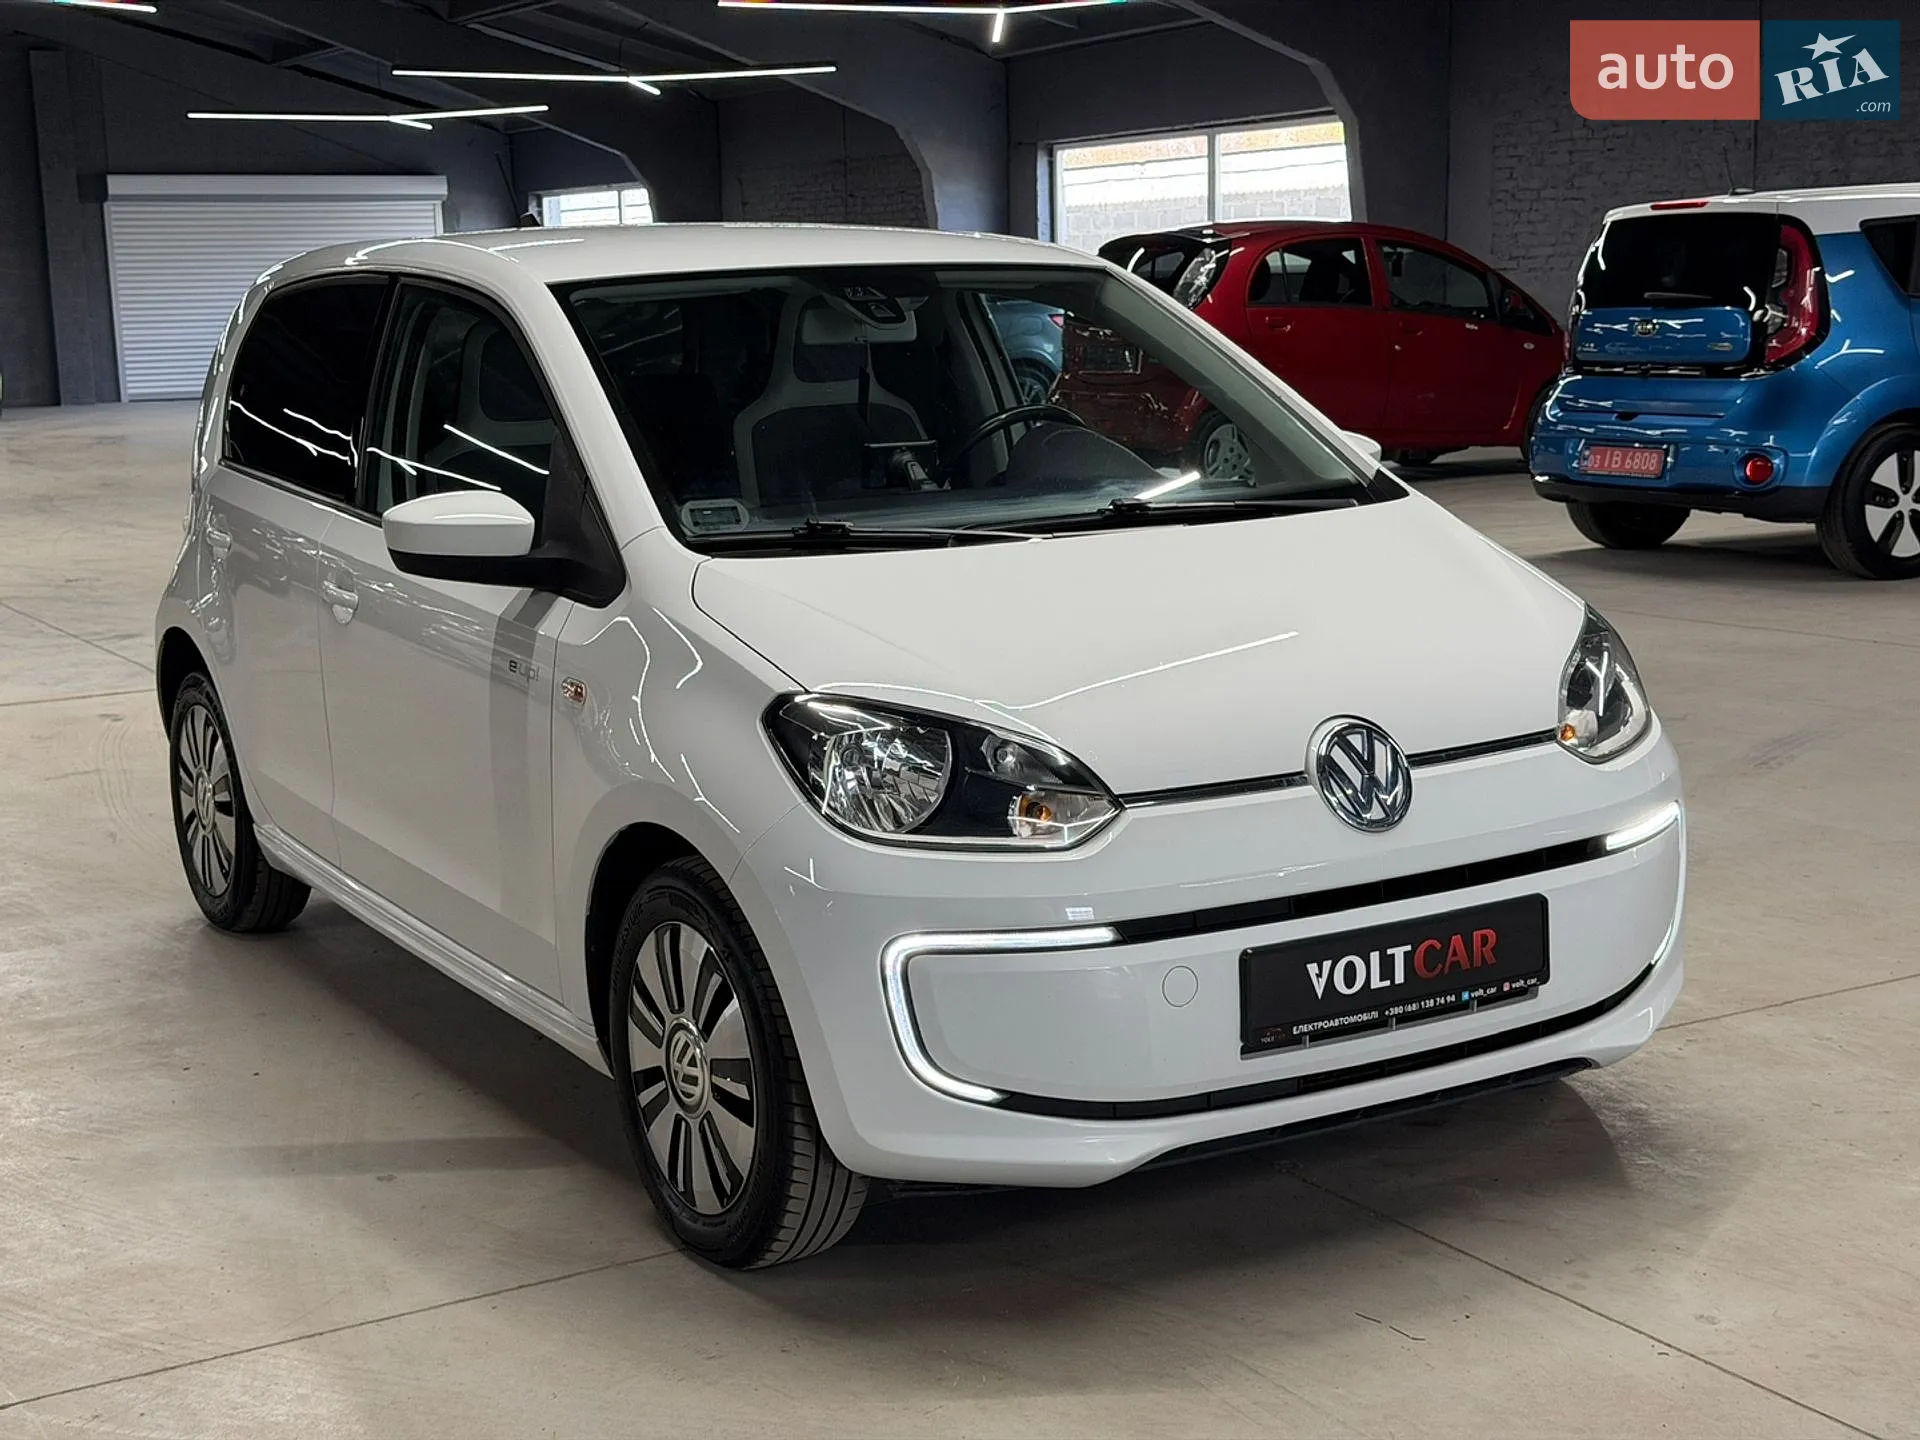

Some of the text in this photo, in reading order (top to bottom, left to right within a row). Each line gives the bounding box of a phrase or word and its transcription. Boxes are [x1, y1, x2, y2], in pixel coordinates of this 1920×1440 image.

[1624, 451, 1658, 471] 6808
[1306, 928, 1498, 1000] VOLTCAR
[1384, 1003, 1404, 1016] +380
[1470, 986, 1498, 998] volt_car
